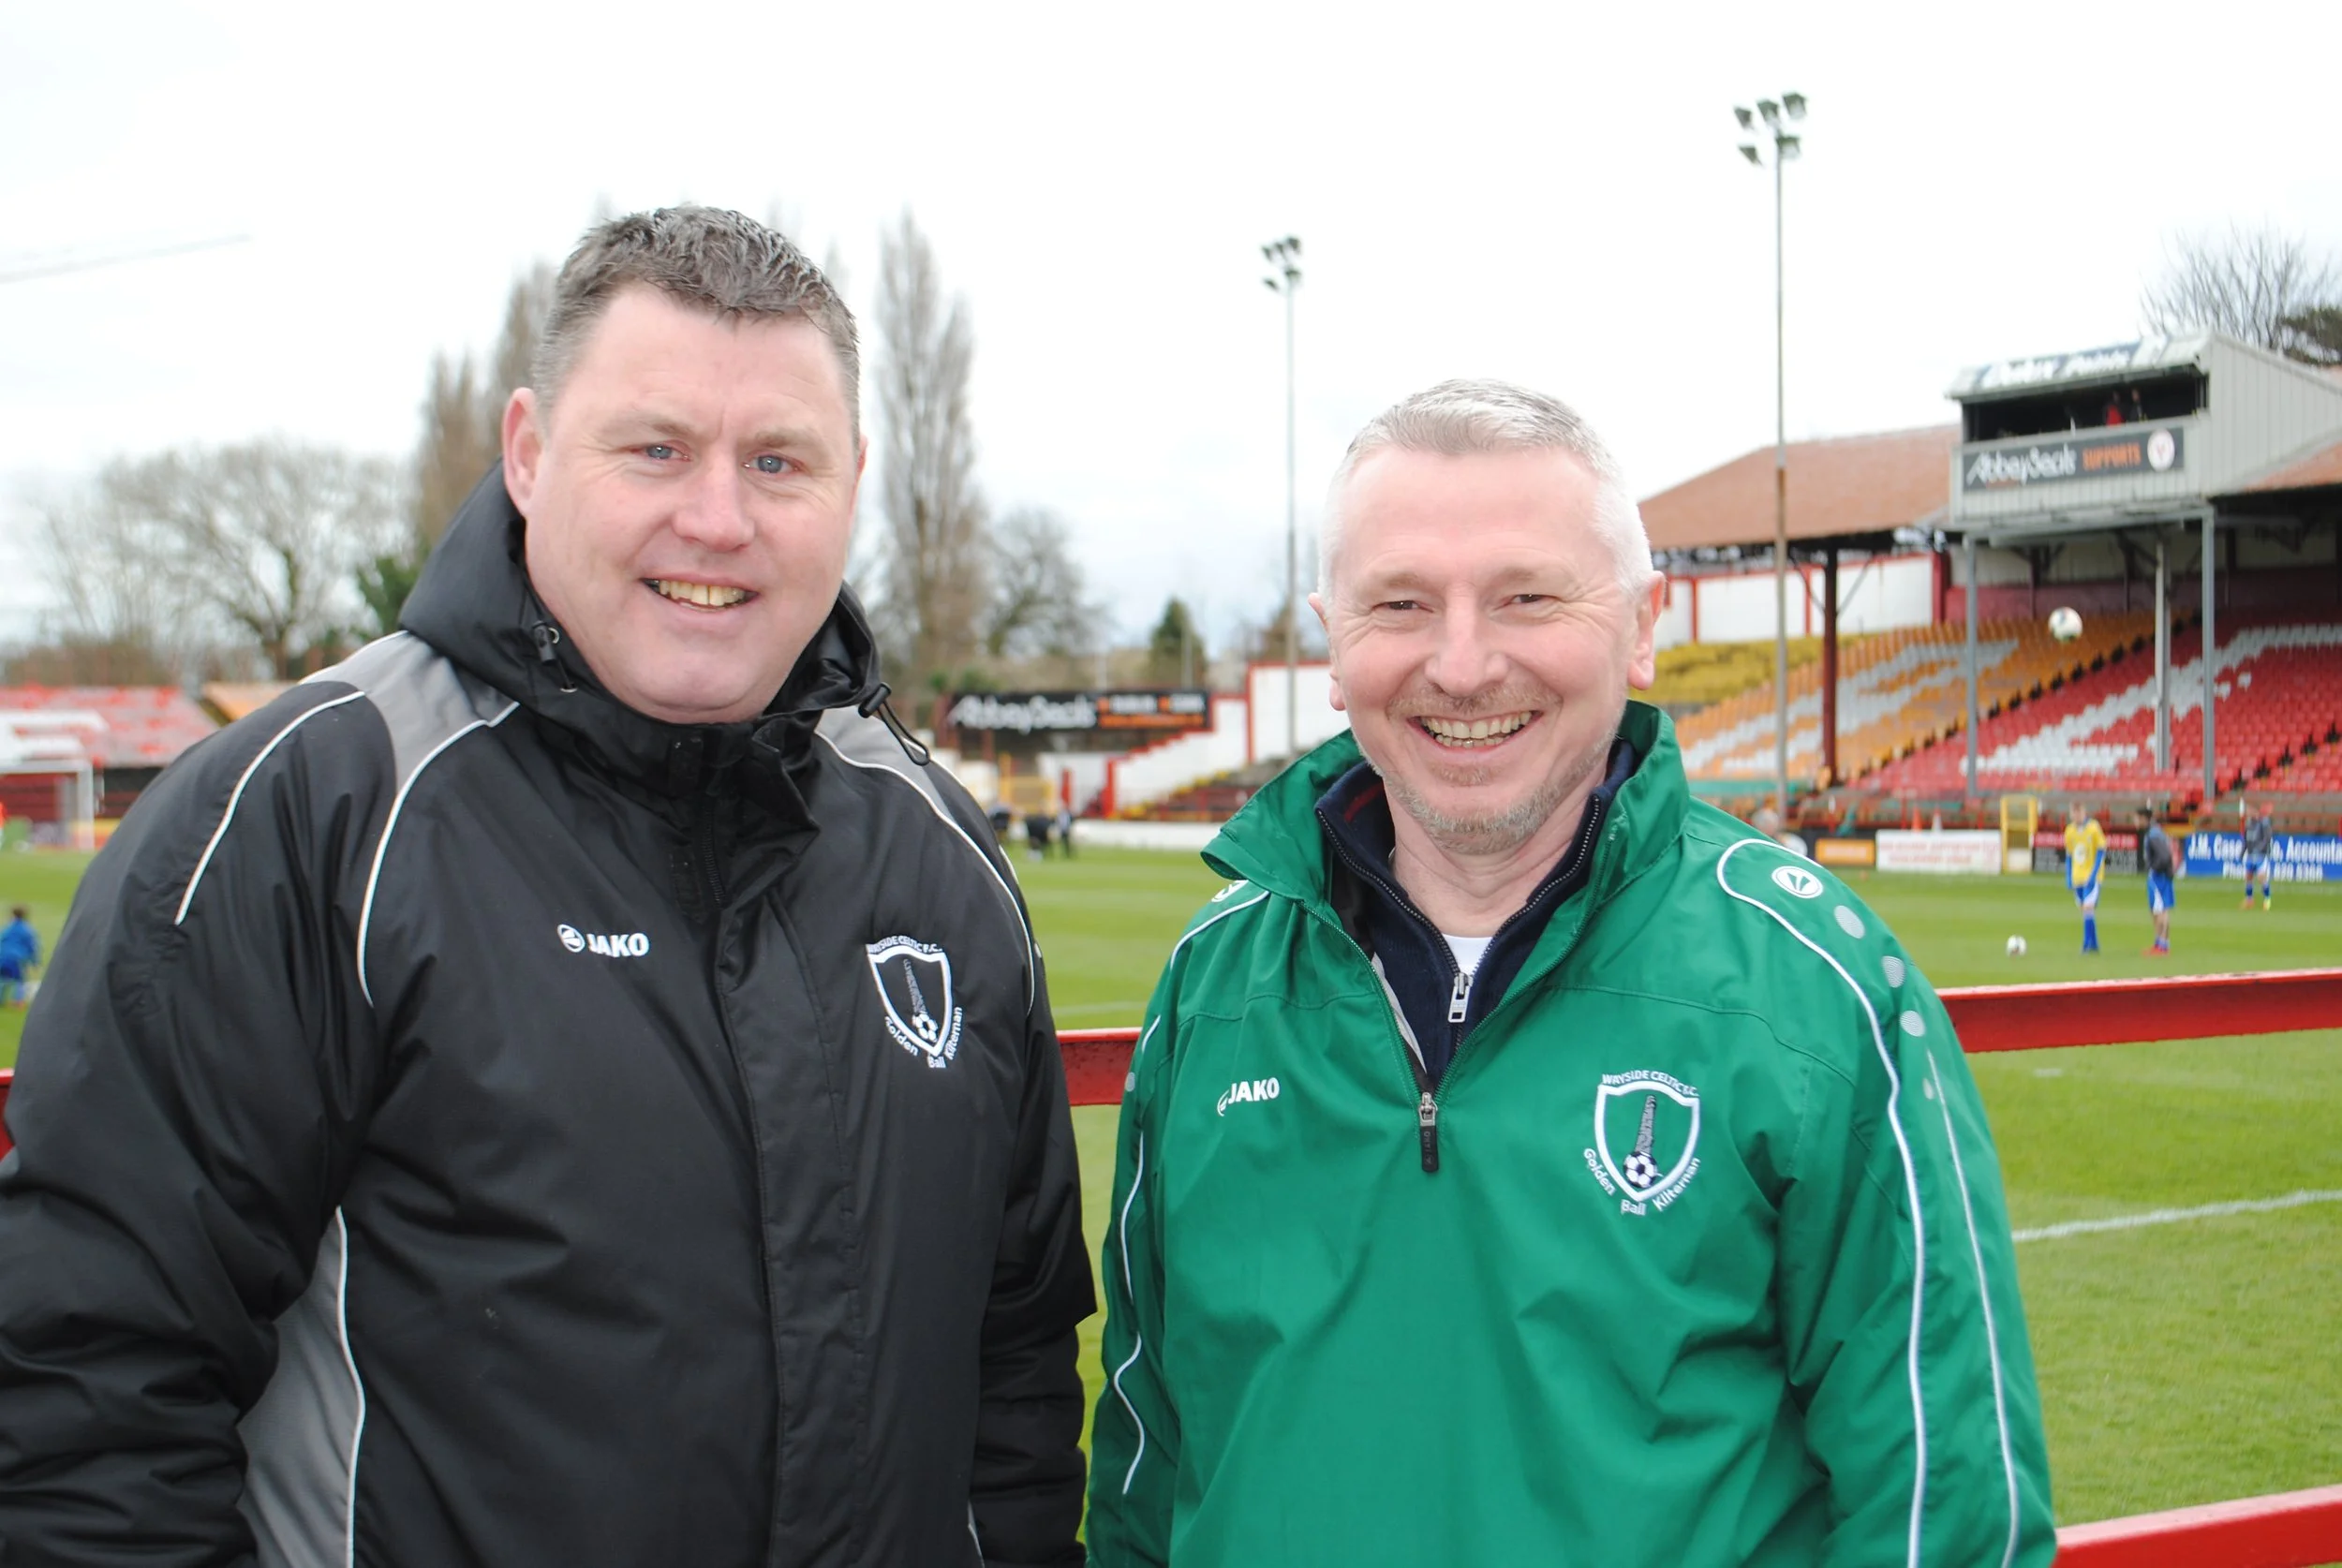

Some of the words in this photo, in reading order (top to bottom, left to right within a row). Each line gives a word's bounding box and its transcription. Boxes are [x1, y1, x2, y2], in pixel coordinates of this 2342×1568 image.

[586, 932, 650, 958] JAKO
[926, 1054, 946, 1069] Ball
[1228, 1077, 1280, 1104] JAKO
[1602, 1070, 1651, 1085] WAYSIDE
[1583, 1148, 1617, 1196] Golden
[1621, 1199, 1647, 1216] Ball
